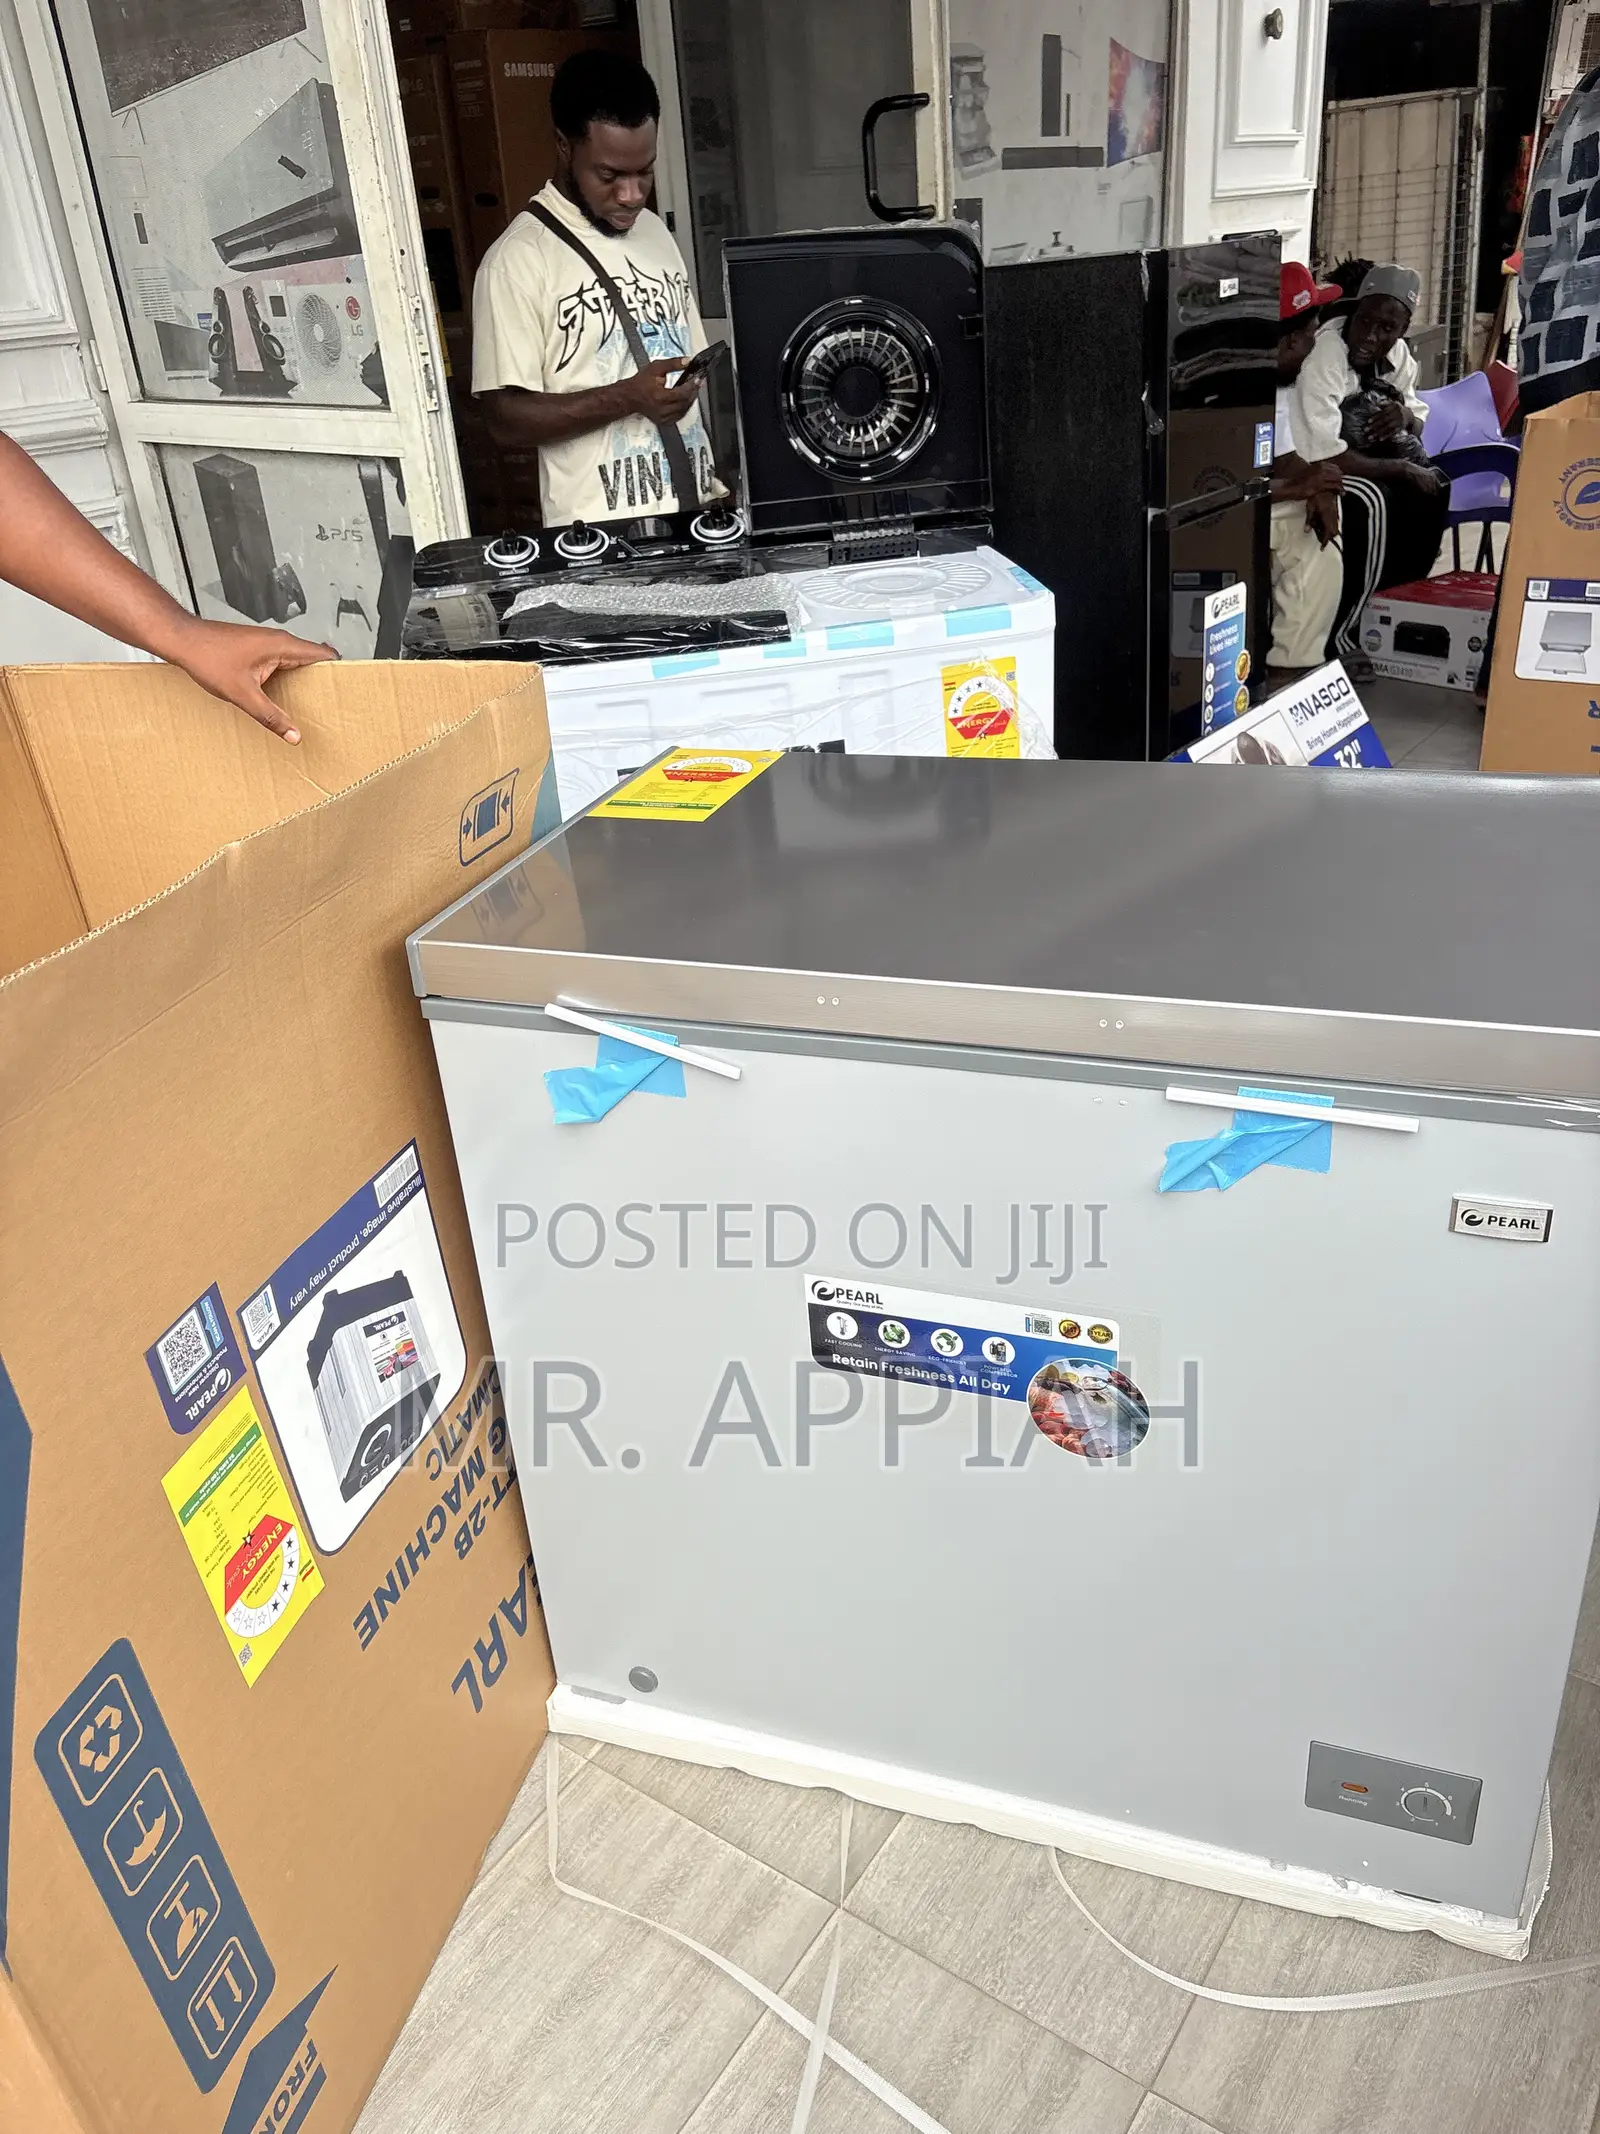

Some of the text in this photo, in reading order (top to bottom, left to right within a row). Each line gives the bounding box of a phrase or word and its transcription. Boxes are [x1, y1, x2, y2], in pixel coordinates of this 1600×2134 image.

[503, 63, 555, 77] SAMSUNG
[351, 325, 363, 336] LG
[330, 528, 363, 542] PS5
[1220, 593, 1240, 610] PEARL
[1298, 676, 1351, 721] NASCO
[1306, 708, 1363, 750] Bring Home Happiness
[387, 1173, 423, 1213] Illustrative
[359, 1213, 387, 1238] image,
[1487, 1215, 1540, 1230] PEARL
[328, 1234, 360, 1272] product
[309, 1269, 327, 1289] may
[290, 1287, 309, 1311] vary
[835, 1287, 883, 1305] PEARL
[373, 1320, 391, 1331] PEARL
[1093, 1330, 1111, 1338] YEAR
[837, 1340, 863, 1349] COOLING
[874, 1346, 916, 1357] ENERGY SAVING
[200, 1363, 220, 1383] Discover
[832, 1353, 1011, 1396] Retain Freshness All Day
[185, 1383, 218, 1420] PEARL
[240, 1522, 285, 1581] ENERGY
[352, 1444, 486, 1652] MACHINE
[1338, 1795, 1368, 1807] Running
